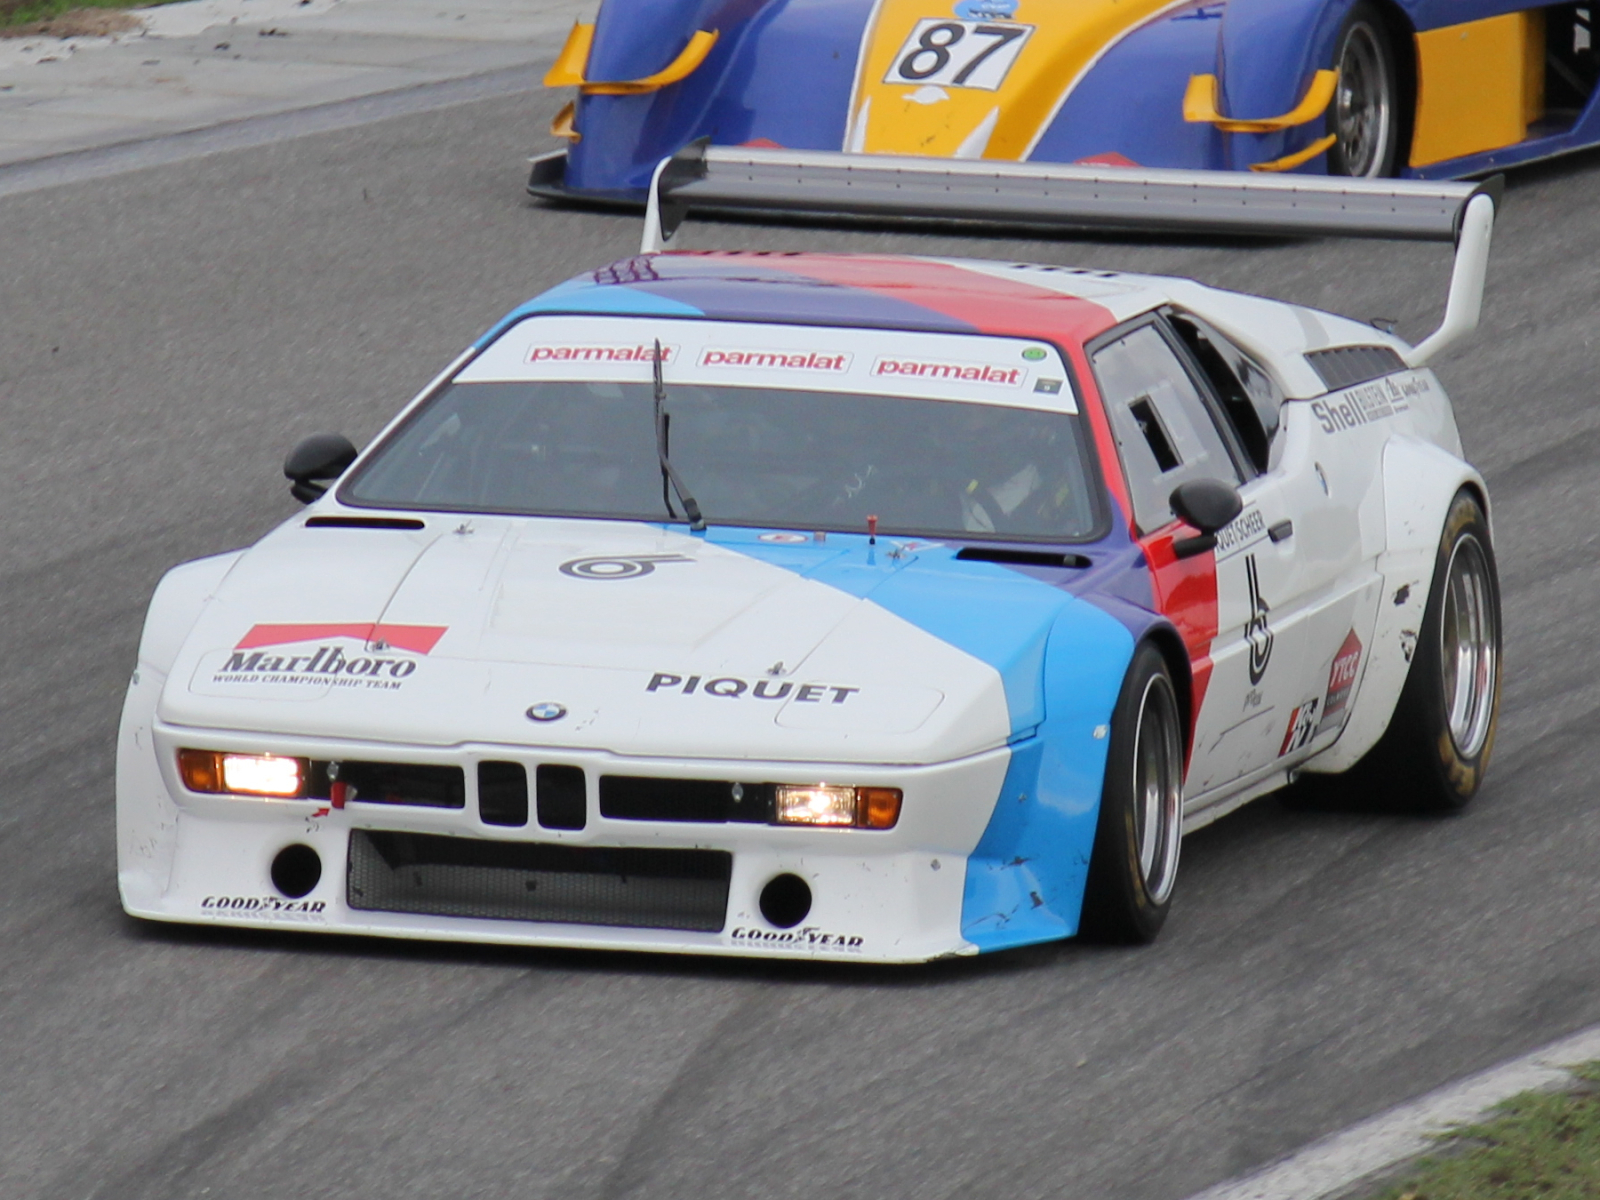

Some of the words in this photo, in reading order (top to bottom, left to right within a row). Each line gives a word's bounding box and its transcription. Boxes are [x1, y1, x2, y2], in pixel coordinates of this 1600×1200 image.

[898, 22, 1026, 84] 87
[530, 344, 672, 363] parmalat
[702, 350, 846, 370] parmalat
[877, 359, 1021, 384] parmalat
[1311, 390, 1367, 434] Shell
[558, 554, 697, 580] 6
[1244, 553, 1274, 686] 6
[220, 646, 416, 677] Marlboro
[212, 673, 258, 683] WORLD
[261, 674, 362, 688] CHAMPIONSHIP
[365, 679, 402, 690] TEAM
[646, 672, 860, 704] PIQUET
